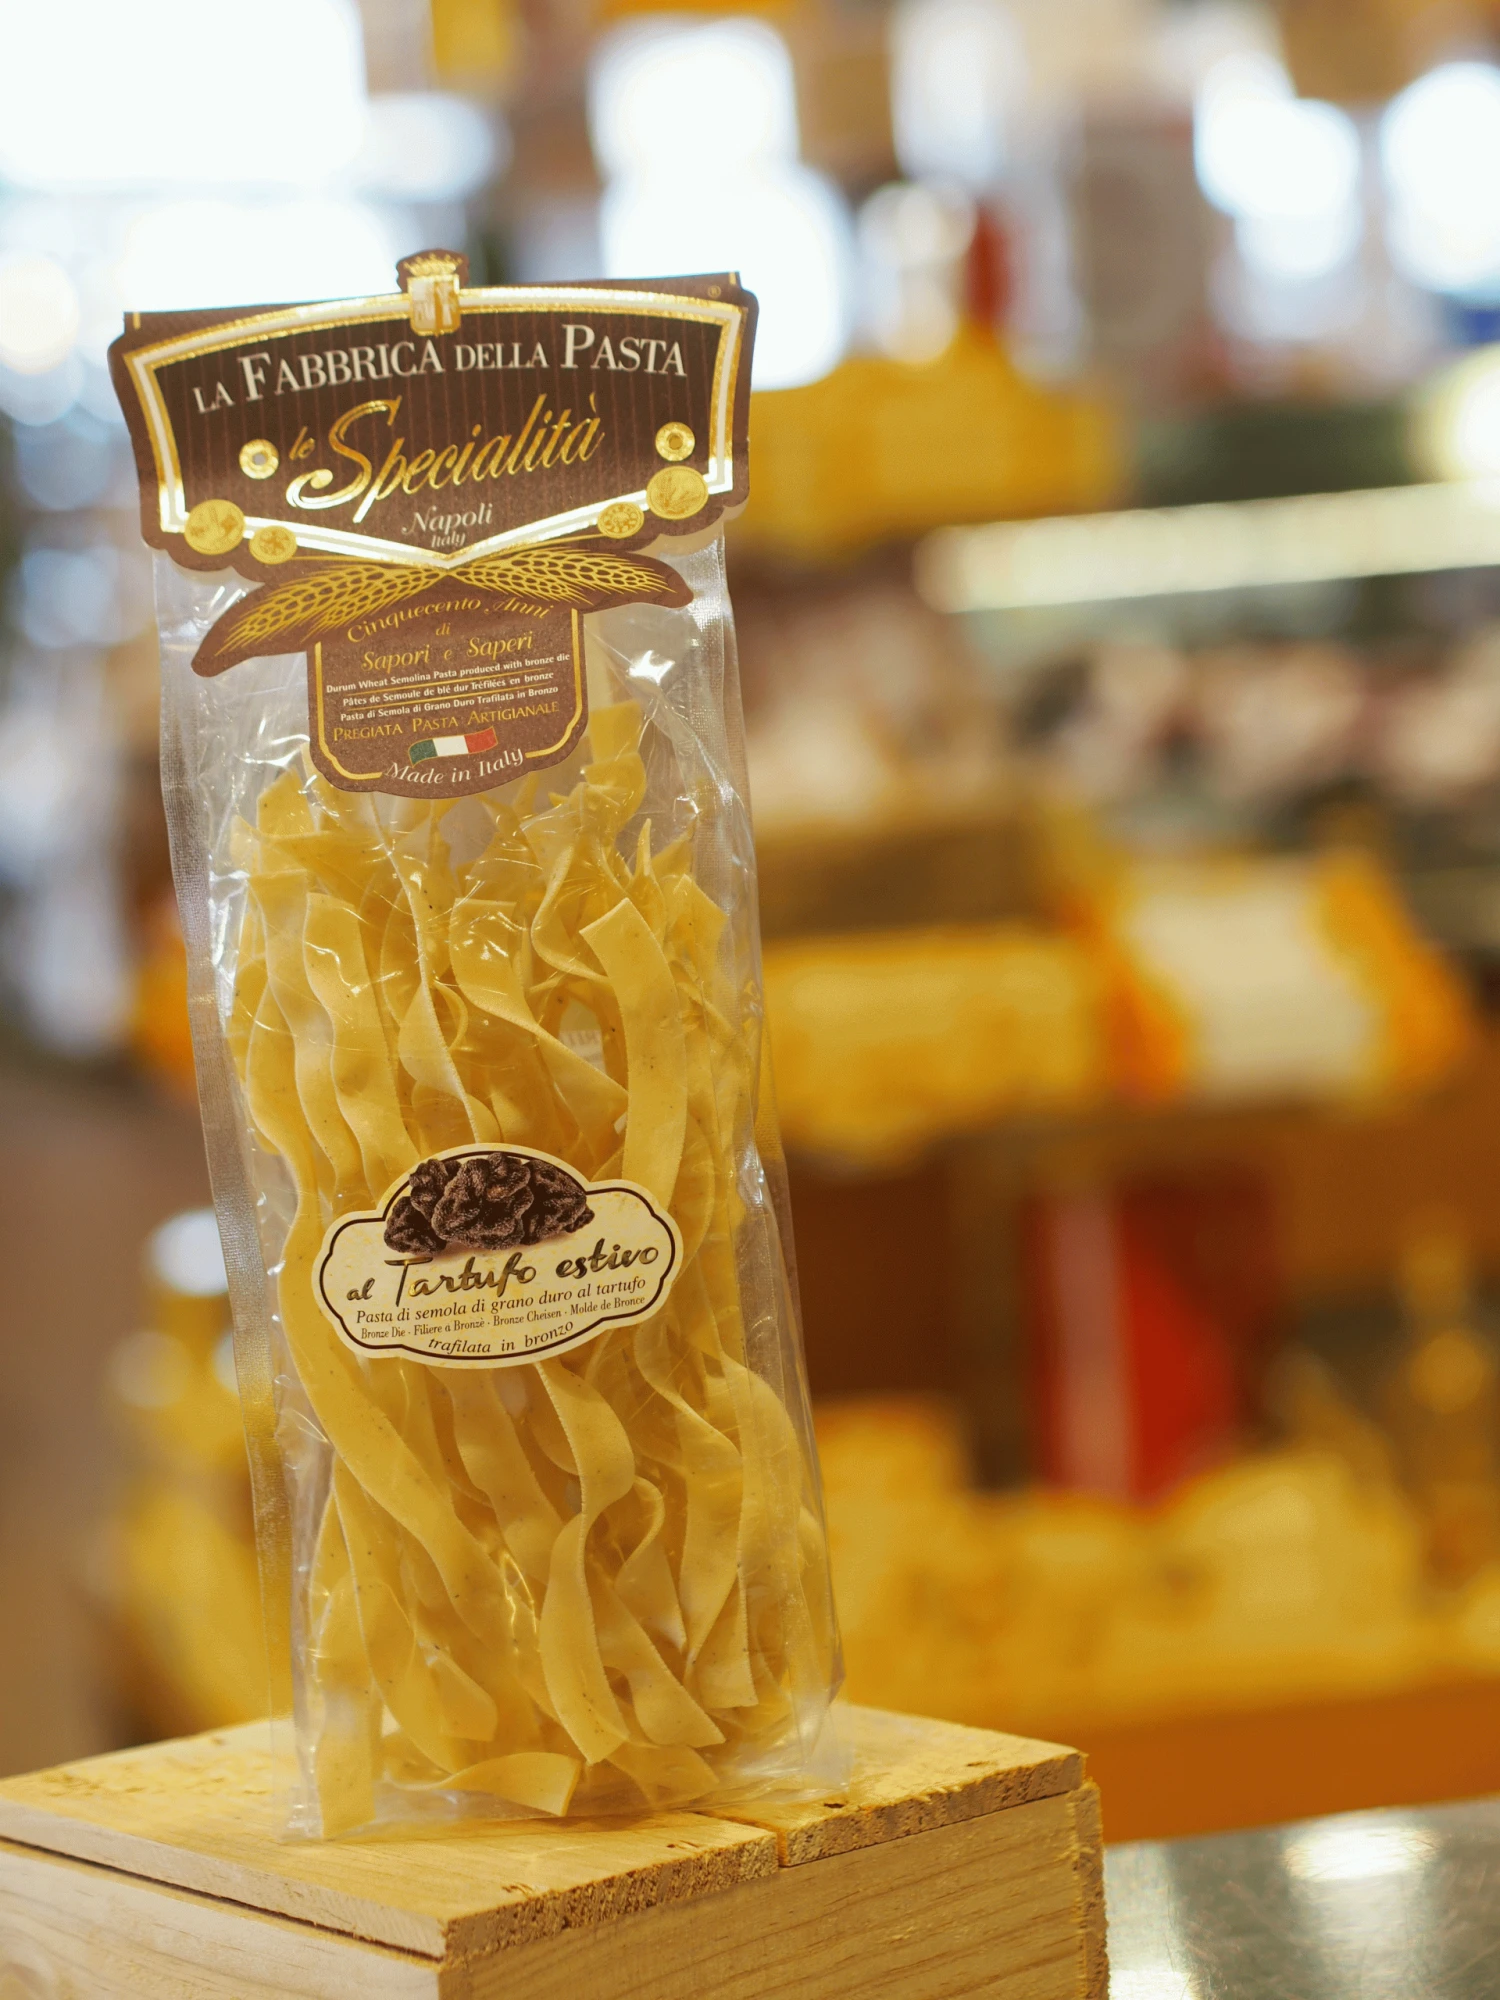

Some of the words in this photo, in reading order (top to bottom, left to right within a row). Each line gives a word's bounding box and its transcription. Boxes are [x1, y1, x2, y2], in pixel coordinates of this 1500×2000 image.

[192, 381, 236, 414] LA
[237, 339, 446, 402] FABBRICA
[454, 341, 550, 372] DELLA
[560, 323, 688, 377] PASTA
[286, 391, 606, 524] Specialità
[401, 502, 493, 535] Napoli
[431, 531, 466, 548] Italy
[347, 597, 482, 643] Cinquecento
[484, 597, 554, 619] Anni
[435, 622, 451, 636] di
[326, 682, 357, 694] Durum
[359, 678, 388, 690] Wheat
[390, 672, 431, 685] Semolina
[433, 669, 457, 680] Pasta
[459, 663, 501, 678] produced
[503, 658, 522, 671] with
[524, 654, 555, 667] bronze
[556, 652, 571, 662] die
[361, 644, 430, 675] Sapori
[443, 649, 453, 661] e
[466, 630, 534, 661] Saperi
[340, 712, 365, 722] Pasta
[366, 709, 376, 719] di
[378, 705, 411, 717] Semola
[412, 703, 422, 713] di
[424, 699, 451, 711] Grano
[453, 698, 475, 708] Duro
[477, 691, 515, 704] Trafilata
[517, 690, 526, 699] in
[528, 685, 559, 698] Bronzo
[343, 697, 367, 707] Pâtes
[369, 695, 381, 704] de
[383, 690, 421, 702] Semoule
[423, 688, 435, 697] de
[437, 685, 451, 695] blé
[453, 683, 470, 693] dur
[471, 677, 506, 690] Tréfilées
[509, 677, 521, 685] en
[524, 671, 554, 683] bronze
[333, 723, 403, 741] PREGIATA
[412, 715, 459, 733] PASTA
[467, 701, 560, 725] ARTIGIANALE
[385, 761, 444, 784] Made
[451, 767, 471, 783] in
[479, 748, 524, 777] Italy
[346, 1277, 375, 1301] al
[384, 1251, 537, 1308] Tartufo
[555, 1237, 659, 1279] estivo
[356, 1310, 393, 1324] Pasta
[396, 1308, 410, 1321] di
[415, 1302, 466, 1320] semola
[471, 1298, 485, 1313] di
[490, 1297, 534, 1315] grano
[538, 1290, 573, 1306] duro
[577, 1283, 592, 1299] al
[596, 1276, 646, 1295] tartufo
[361, 1328, 389, 1340] Bronze
[391, 1326, 406, 1338] Die
[413, 1320, 442, 1336] Filiere
[493, 1315, 524, 1327] Bronze
[526, 1309, 562, 1323] Cheisen
[570, 1303, 598, 1317] Molde
[600, 1300, 612, 1311] de
[614, 1296, 646, 1310] Bronce
[428, 1337, 492, 1356] trafilata
[500, 1338, 516, 1353] in
[524, 1320, 574, 1348] bronzo
